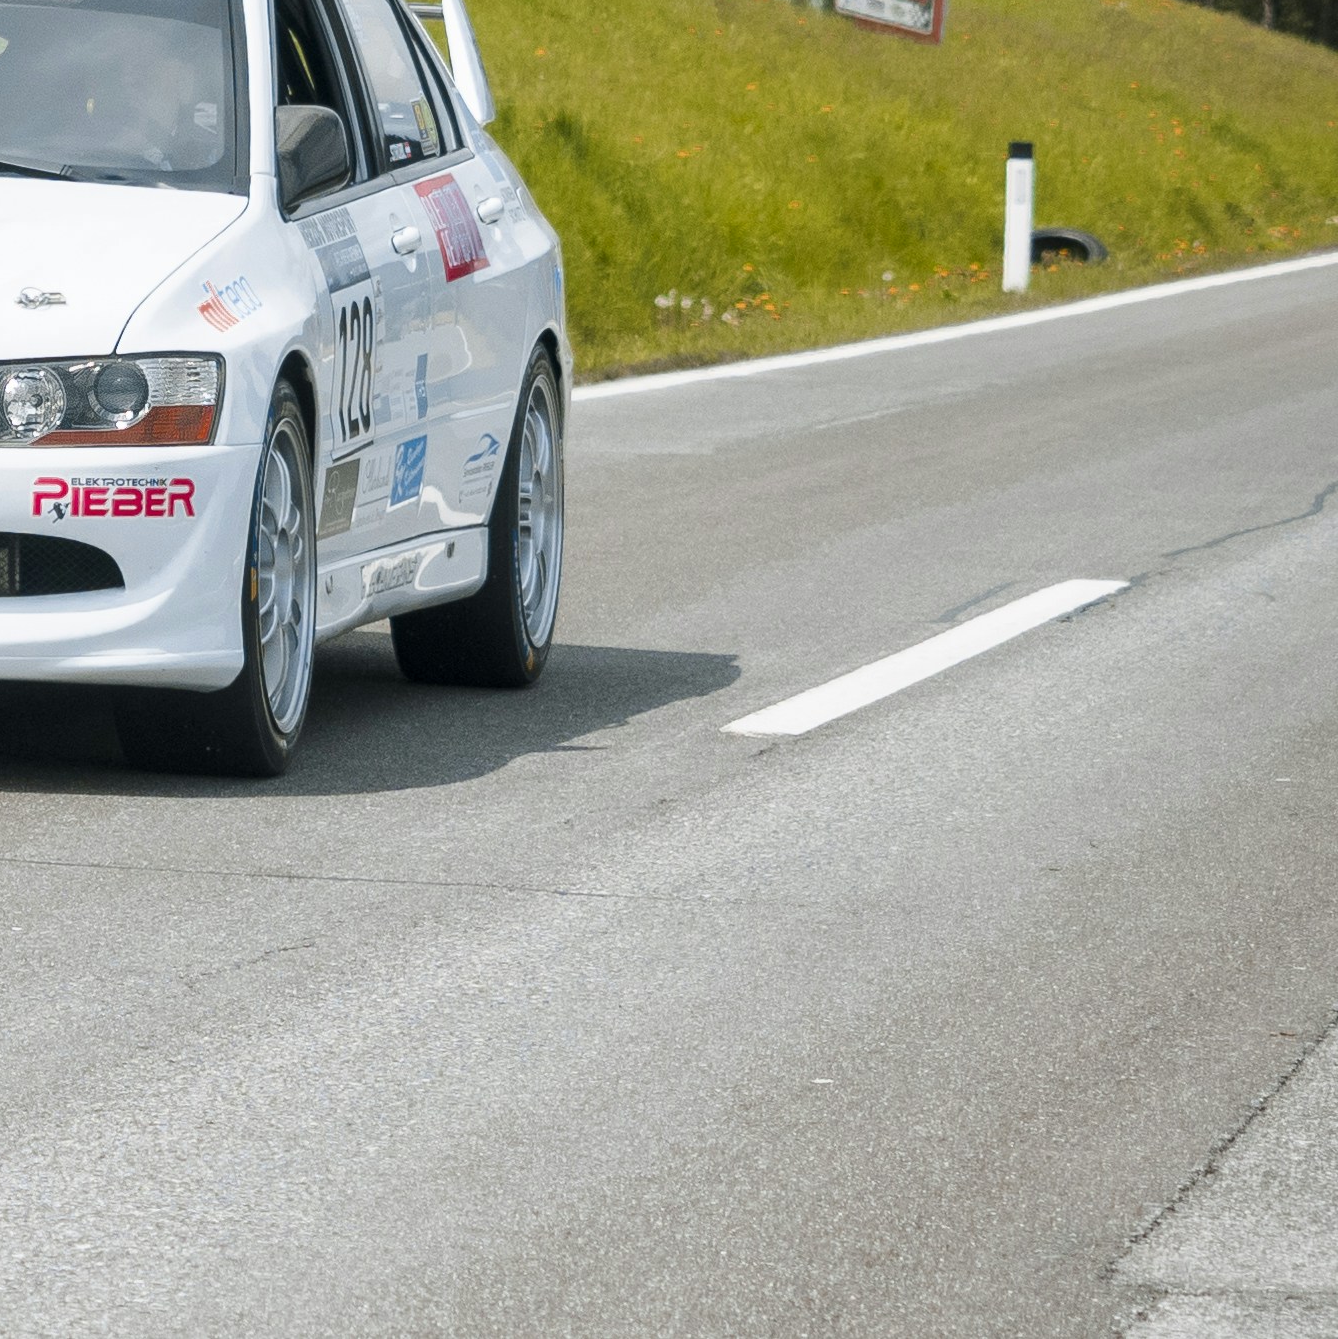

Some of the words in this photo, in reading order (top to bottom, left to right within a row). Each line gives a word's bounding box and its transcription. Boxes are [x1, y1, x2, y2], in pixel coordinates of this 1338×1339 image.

[338, 296, 373, 443] 128
[32, 477, 196, 517] PIEBER
[71, 477, 168, 487] ELEKTROTECHNIK
